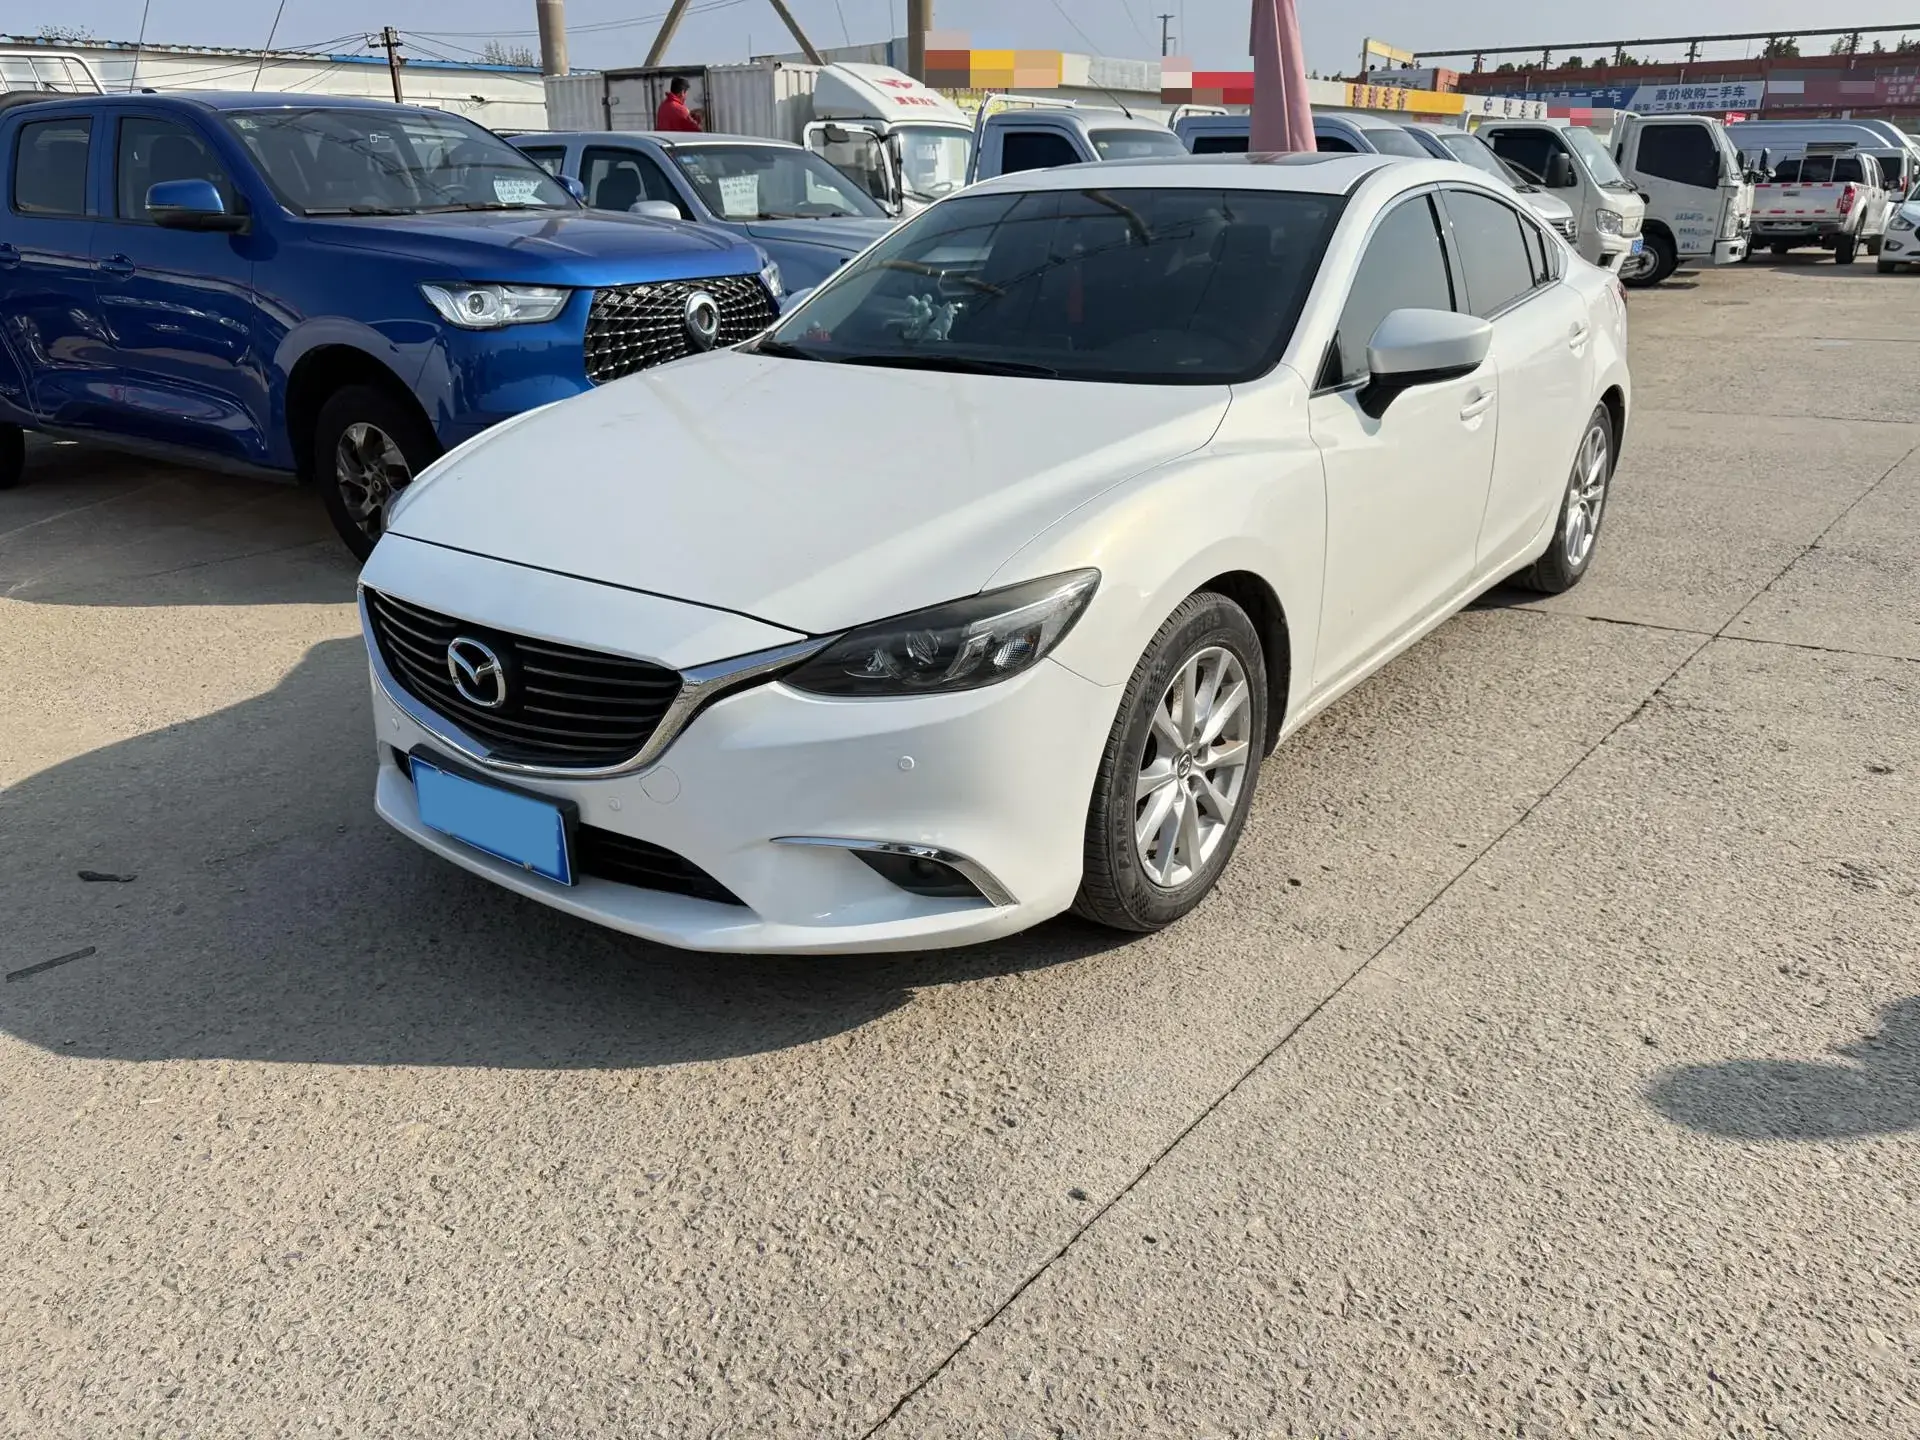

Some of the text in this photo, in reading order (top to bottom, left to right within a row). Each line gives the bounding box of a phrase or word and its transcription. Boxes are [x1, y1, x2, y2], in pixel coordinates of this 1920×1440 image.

[1655, 85, 1747, 101] 高价收购二手车
